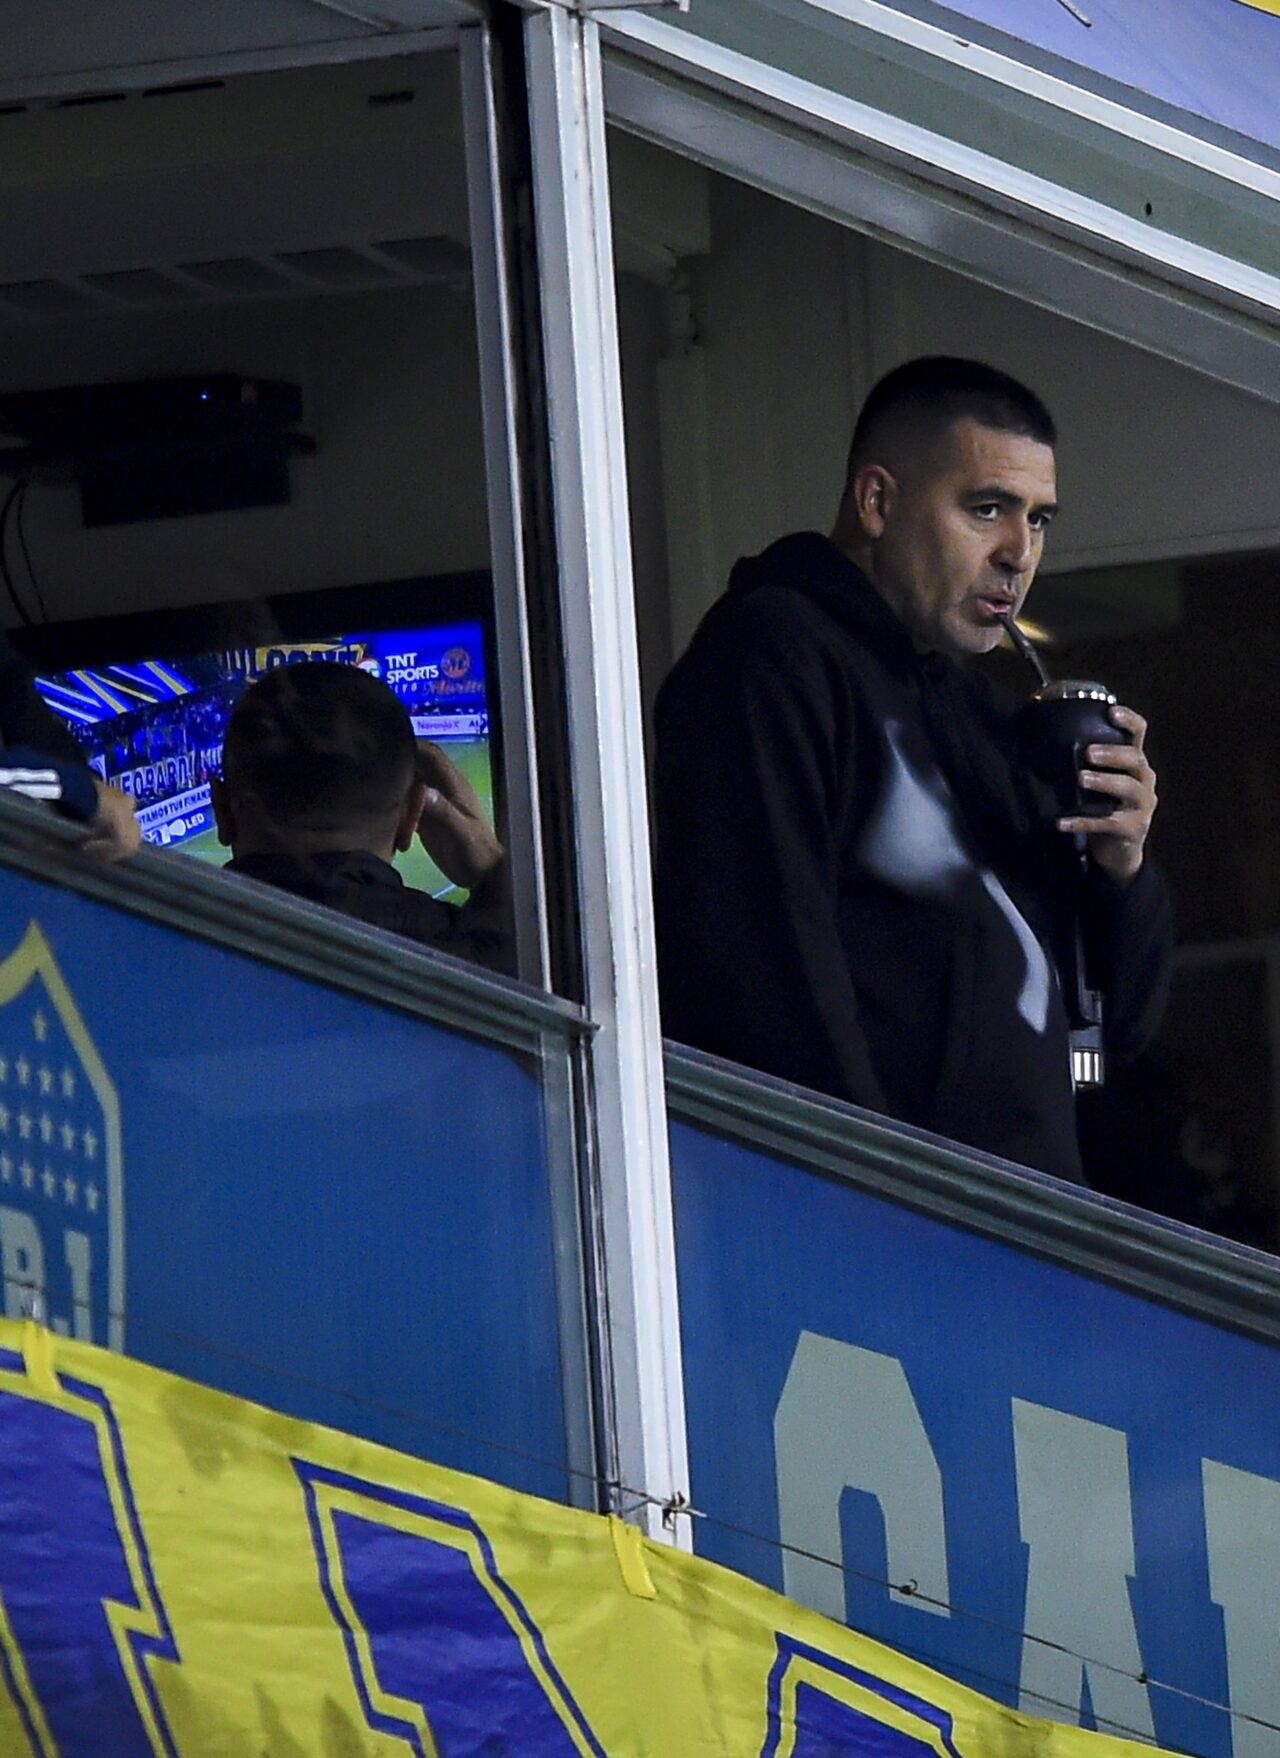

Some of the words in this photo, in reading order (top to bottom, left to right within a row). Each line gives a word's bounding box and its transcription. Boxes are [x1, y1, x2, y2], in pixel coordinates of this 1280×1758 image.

[385, 652, 417, 669] TNT
[387, 665, 439, 685] SPORTS
[389, 682, 418, 694] IVO
[186, 813, 205, 829] LED
